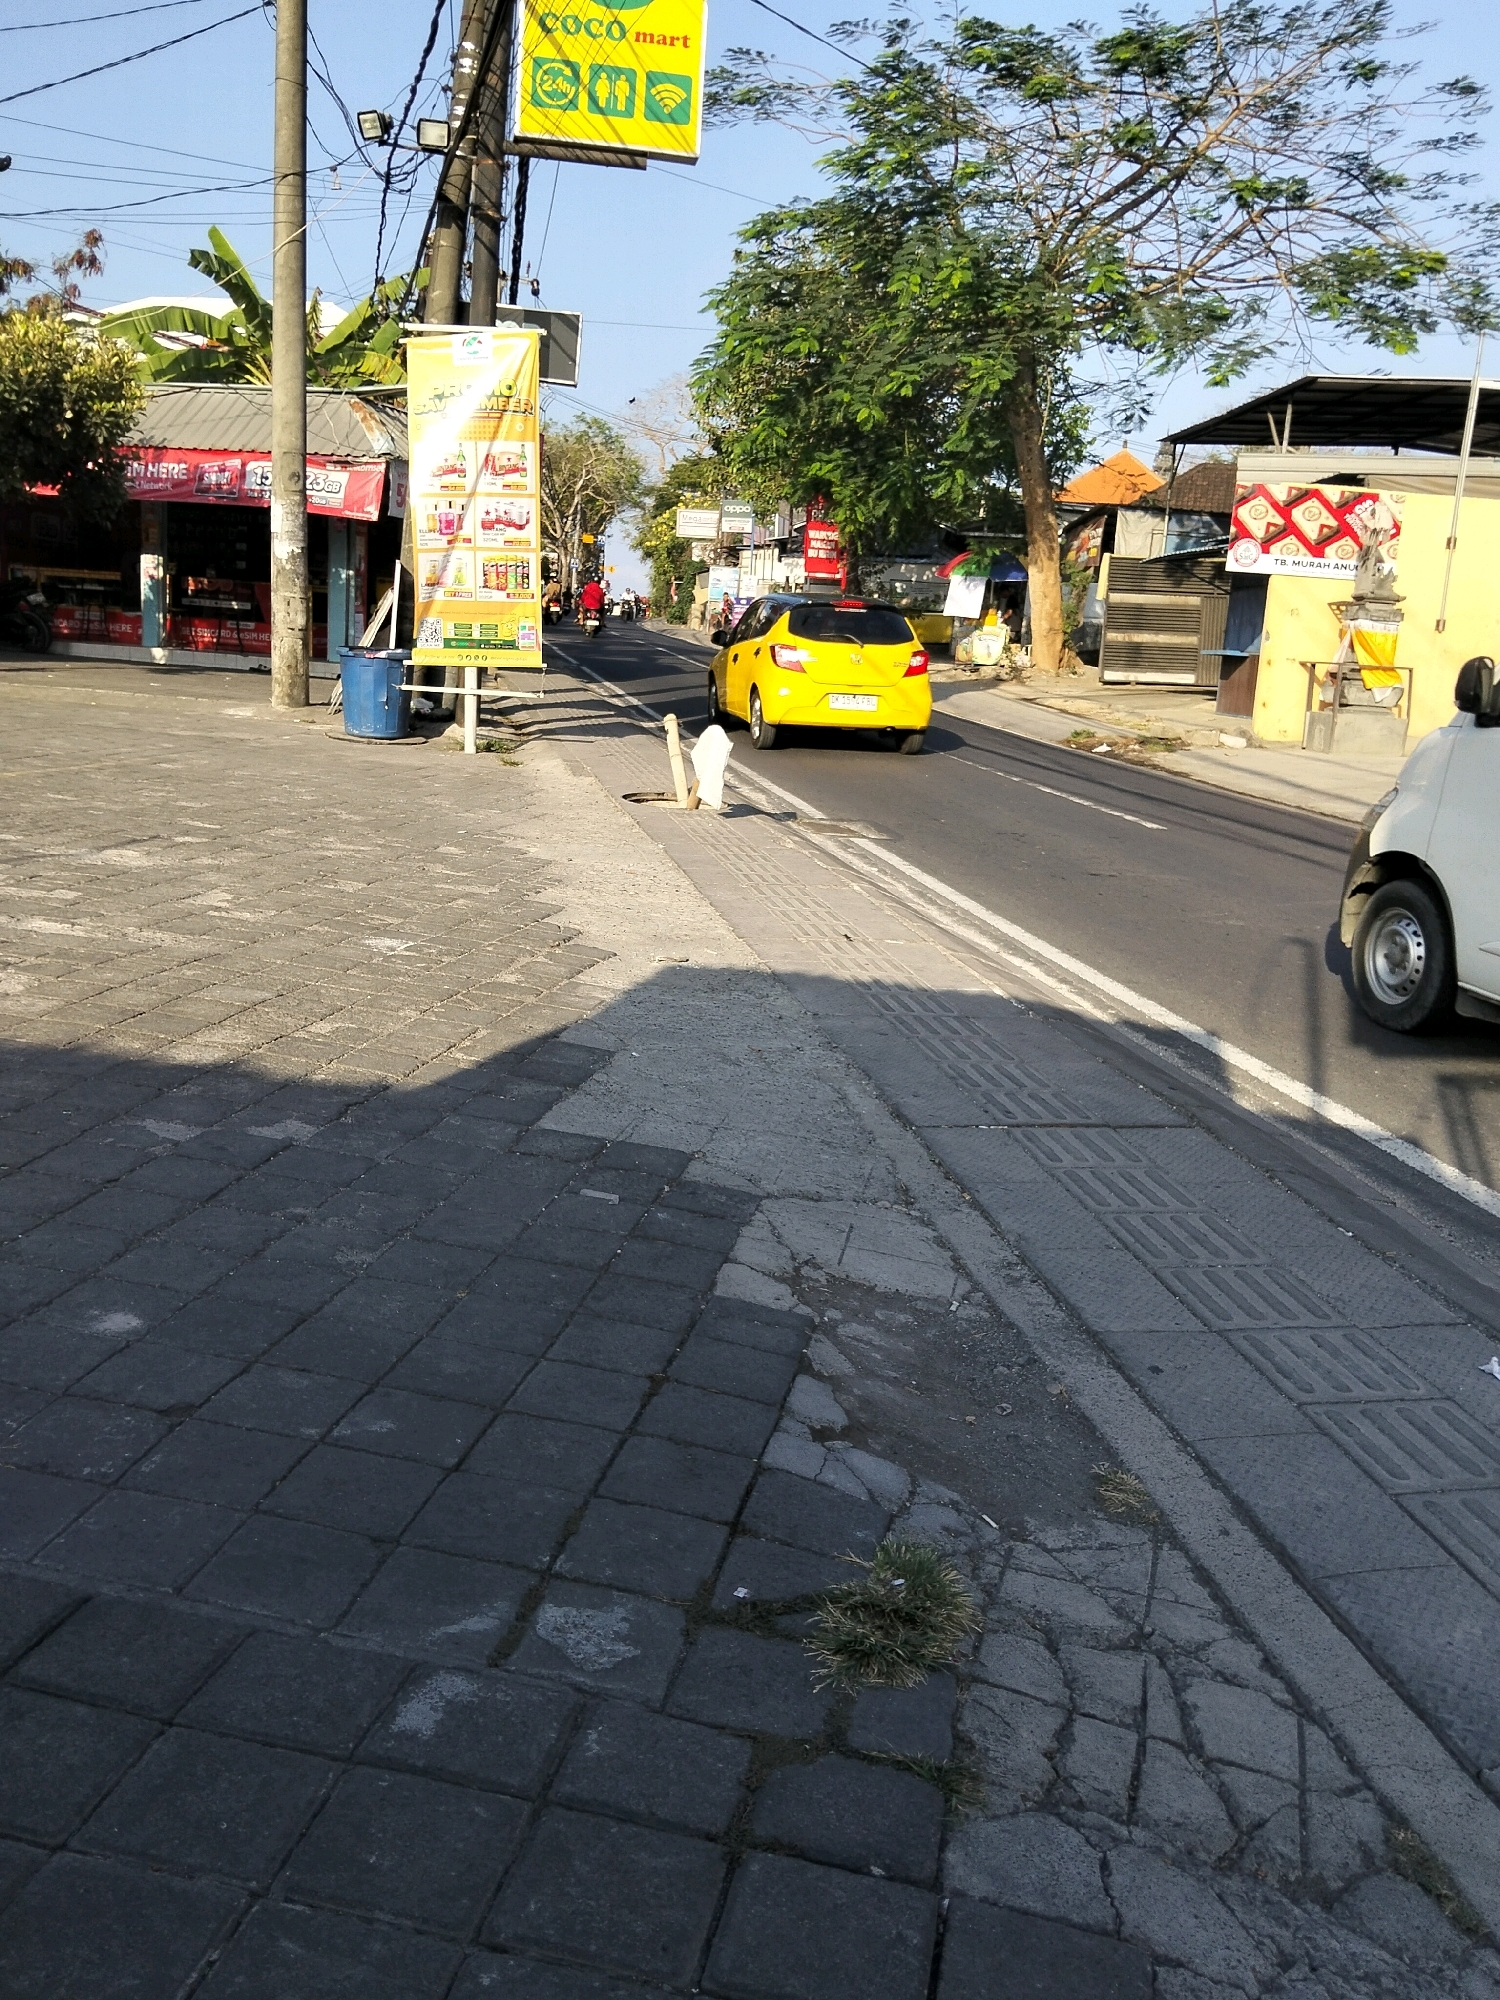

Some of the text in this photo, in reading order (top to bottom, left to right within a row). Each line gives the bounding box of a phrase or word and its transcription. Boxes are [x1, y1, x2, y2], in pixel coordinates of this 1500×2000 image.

[634, 30, 691, 49] mart
[542, 75, 571, 94] 24h
[147, 462, 189, 480] HERE
[724, 505, 751, 514] oppo
[1274, 558, 1360, 573] TB. MURAH ANU
[109, 623, 133, 633] HERE
[259, 633, 272, 642] HE
